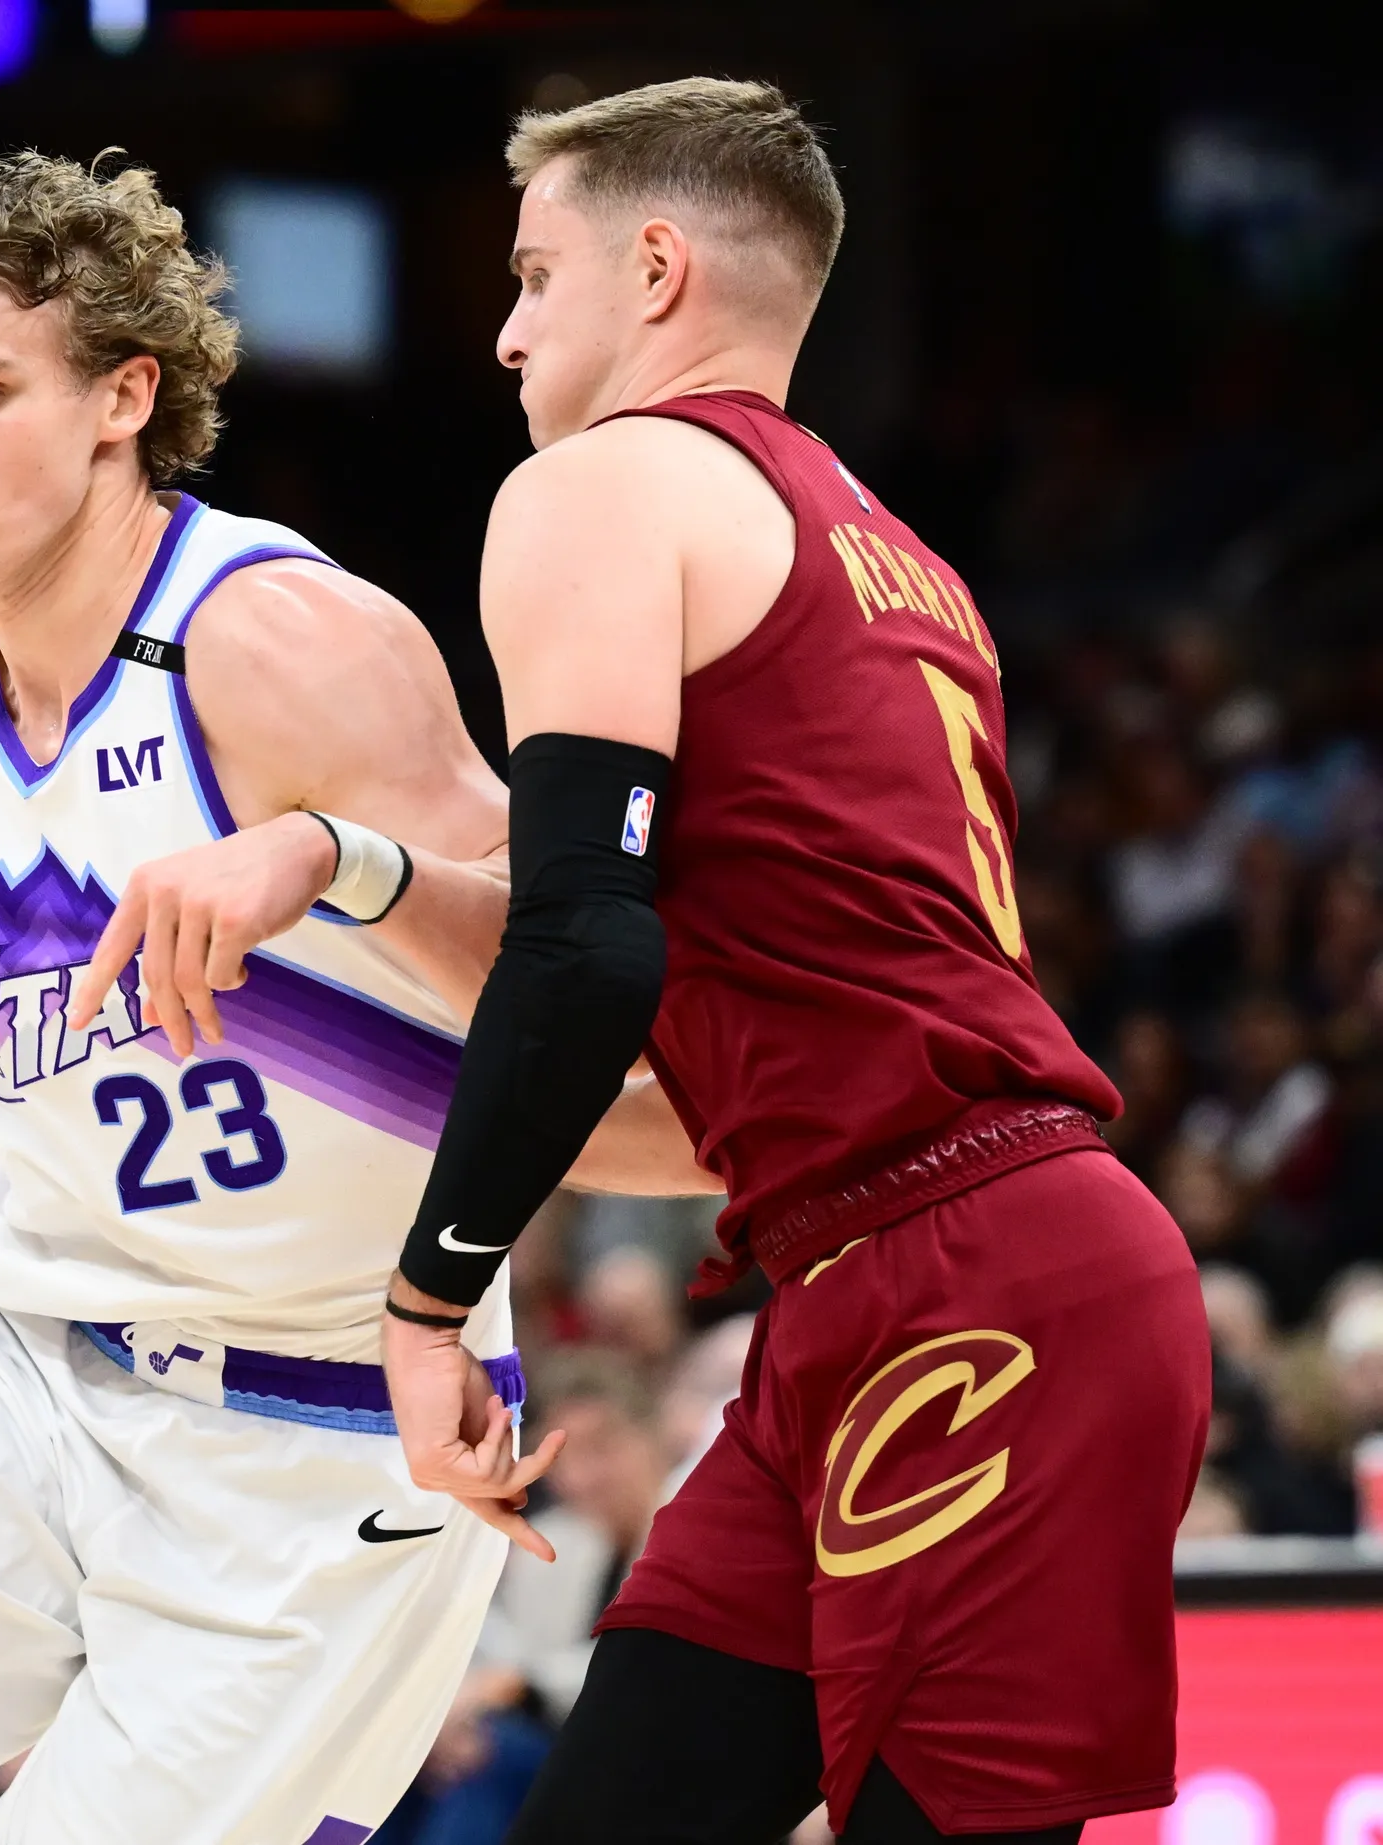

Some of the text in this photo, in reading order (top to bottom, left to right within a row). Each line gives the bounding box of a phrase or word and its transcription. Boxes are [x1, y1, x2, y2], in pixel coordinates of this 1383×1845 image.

[829, 523, 1001, 680] MERRIL
[95, 735, 165, 793] LVT
[918, 657, 1021, 960] 5
[92, 1057, 288, 1215] 23
[815, 1329, 1037, 1577] C
